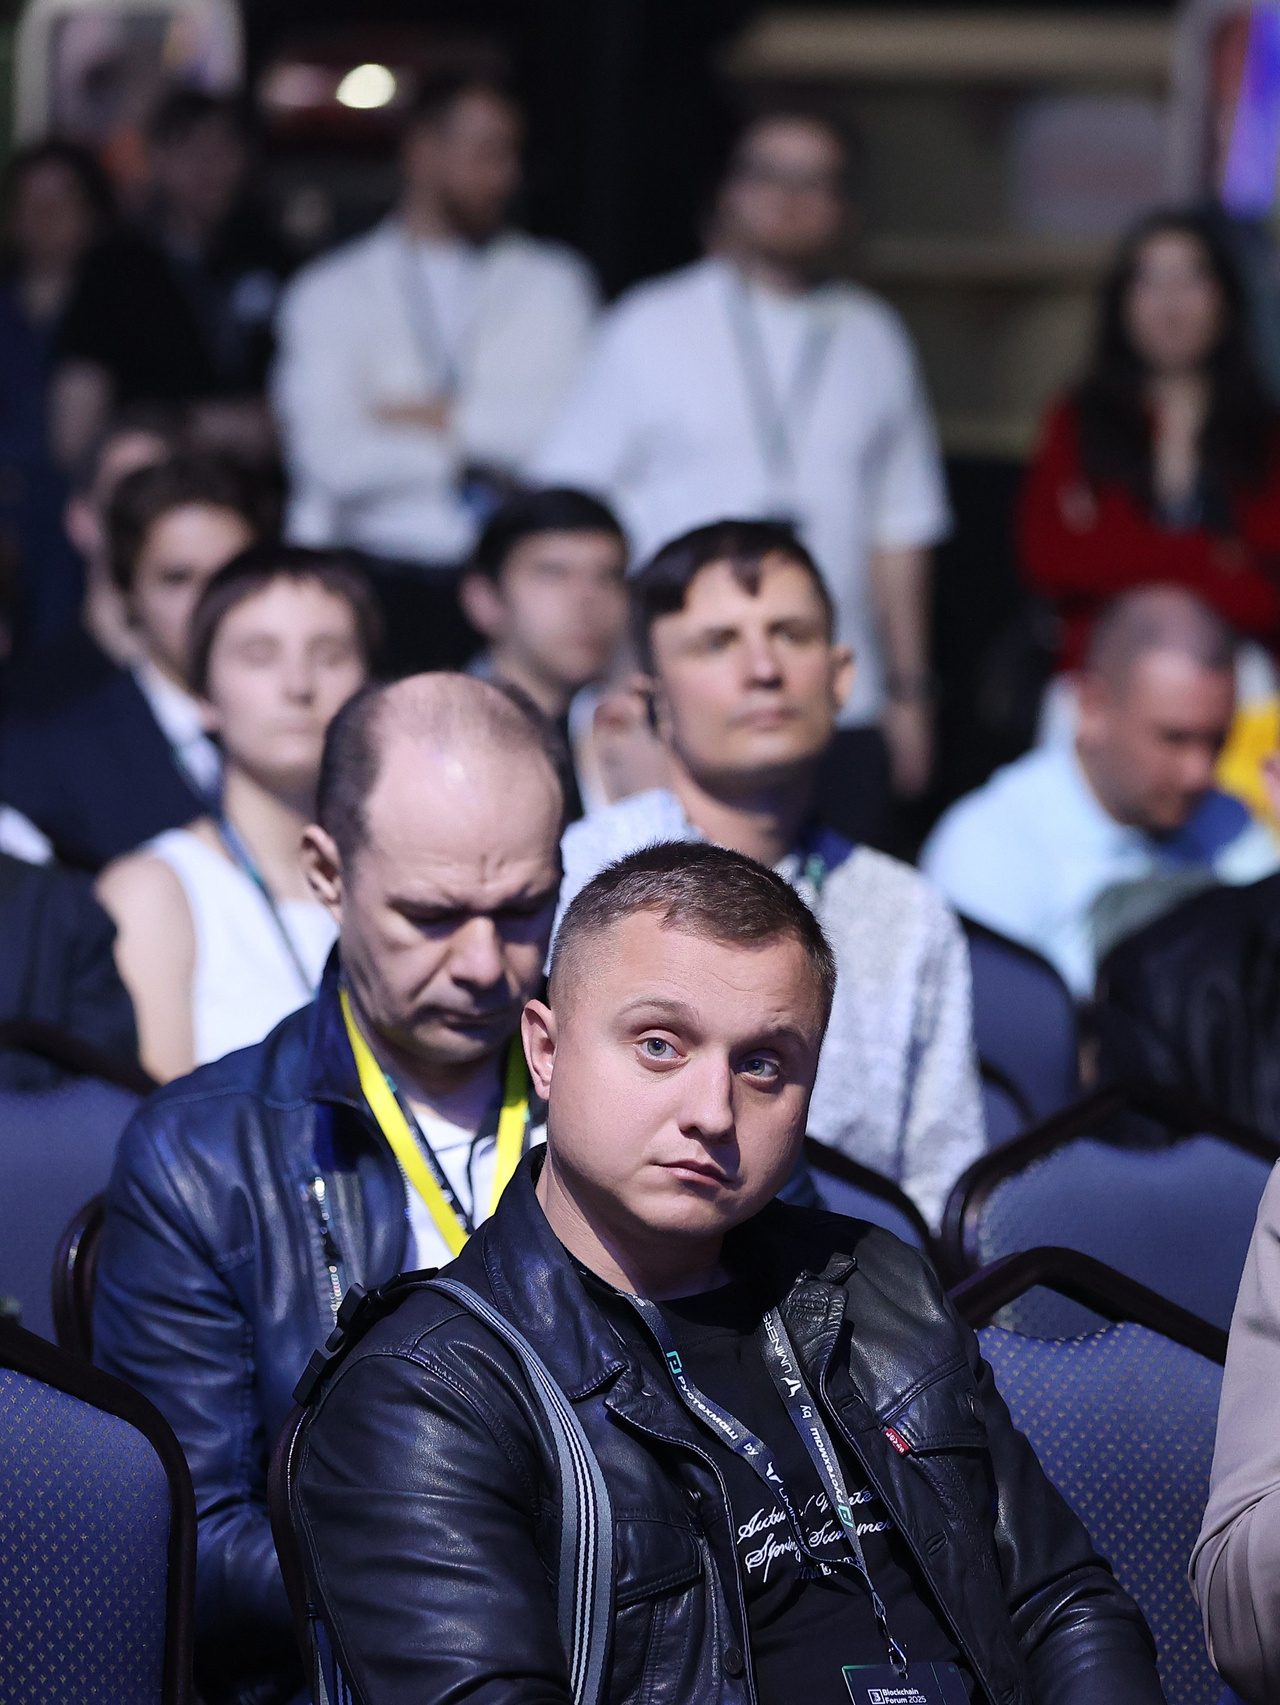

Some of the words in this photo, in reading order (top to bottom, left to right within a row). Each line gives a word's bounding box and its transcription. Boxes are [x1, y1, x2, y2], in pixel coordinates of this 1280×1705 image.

[762, 1311, 793, 1374] UMINERS
[799, 1404, 813, 1419] by
[743, 1442, 759, 1457] by
[882, 1687, 920, 1697] Blockchain
[884, 1696, 908, 1705] Forum
[907, 1695, 927, 1704] 2025
